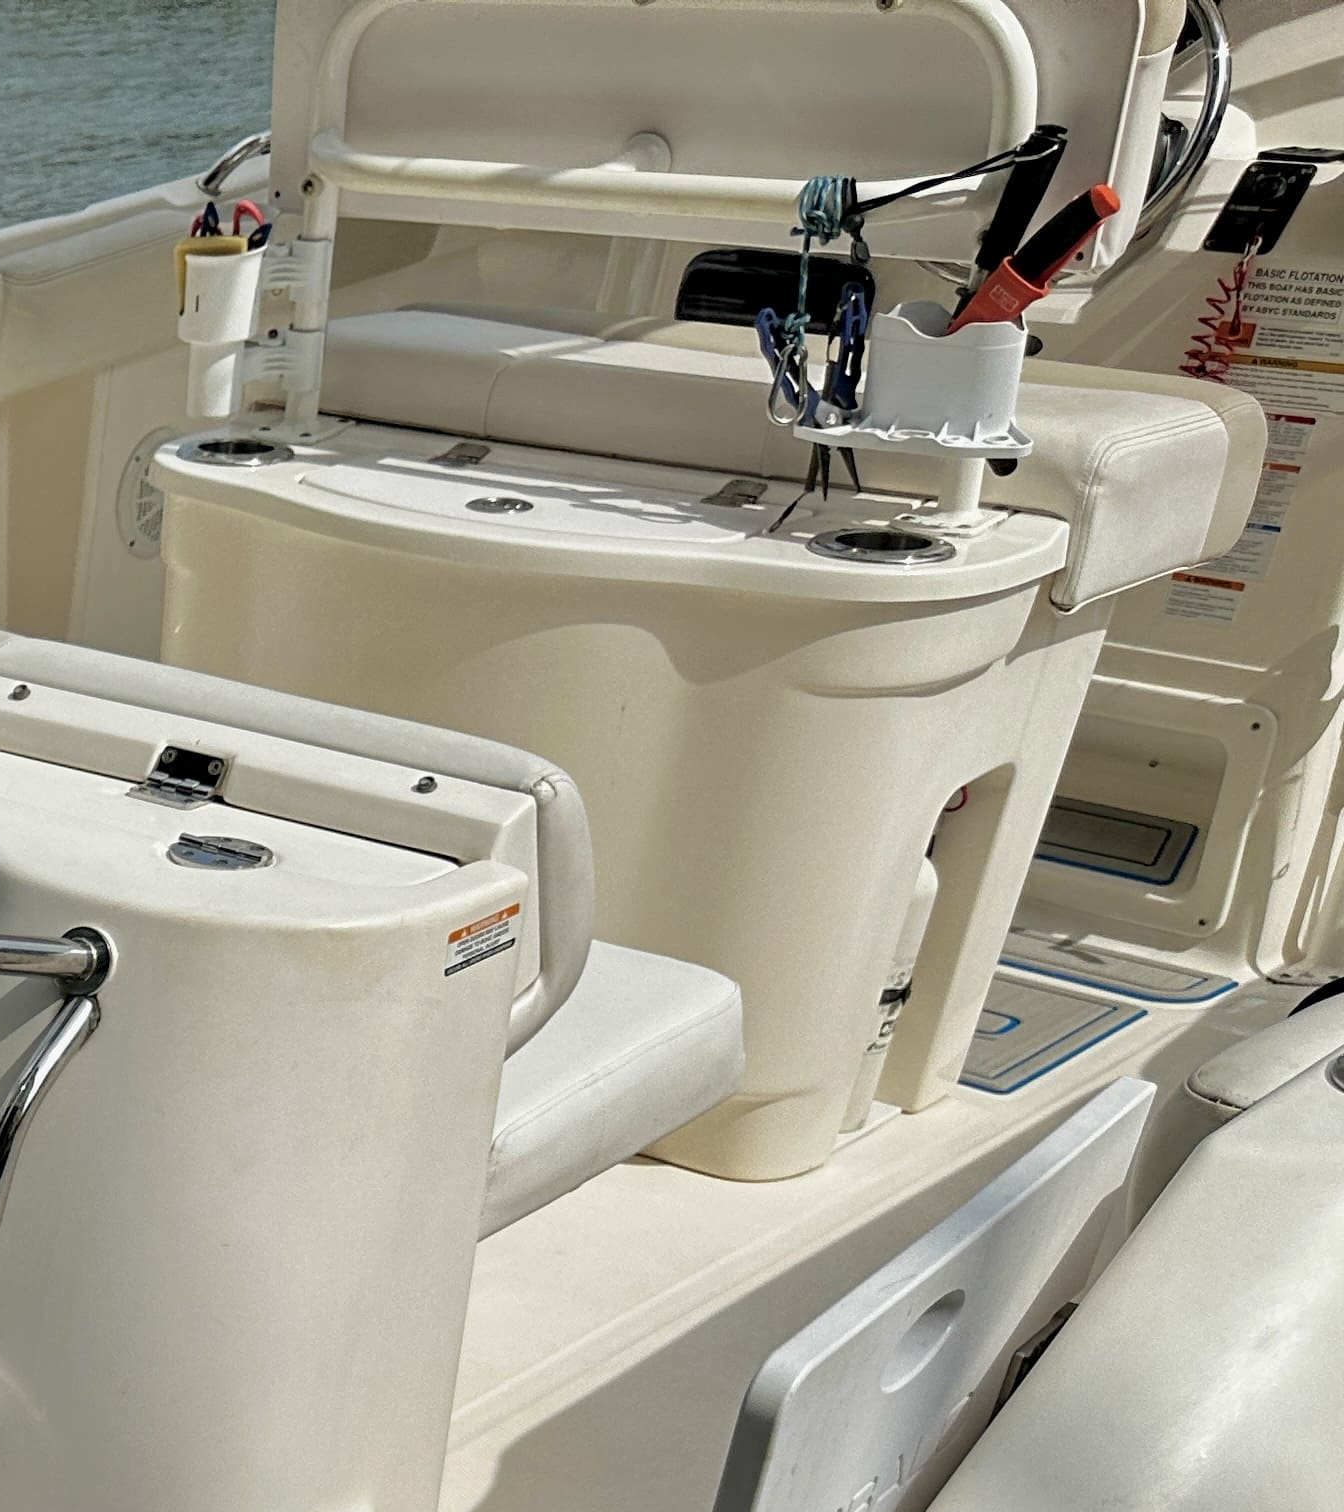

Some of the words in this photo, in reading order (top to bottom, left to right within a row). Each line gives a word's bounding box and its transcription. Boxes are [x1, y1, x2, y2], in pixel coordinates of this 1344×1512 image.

[1255, 268, 1286, 279] BASIC
[1288, 271, 1344, 284] FLOTATION
[1247, 281, 1266, 290] THIS
[1269, 282, 1293, 292] BOAT
[1294, 285, 1313, 294] HAS
[1315, 287, 1344, 297] BASIC
[1243, 293, 1289, 304] FLOTATION
[1290, 297, 1303, 305] AS
[1303, 298, 1342, 308] DEFINED
[1256, 306, 1279, 316] ABYC
[1281, 308, 1337, 320] STANDARDS
